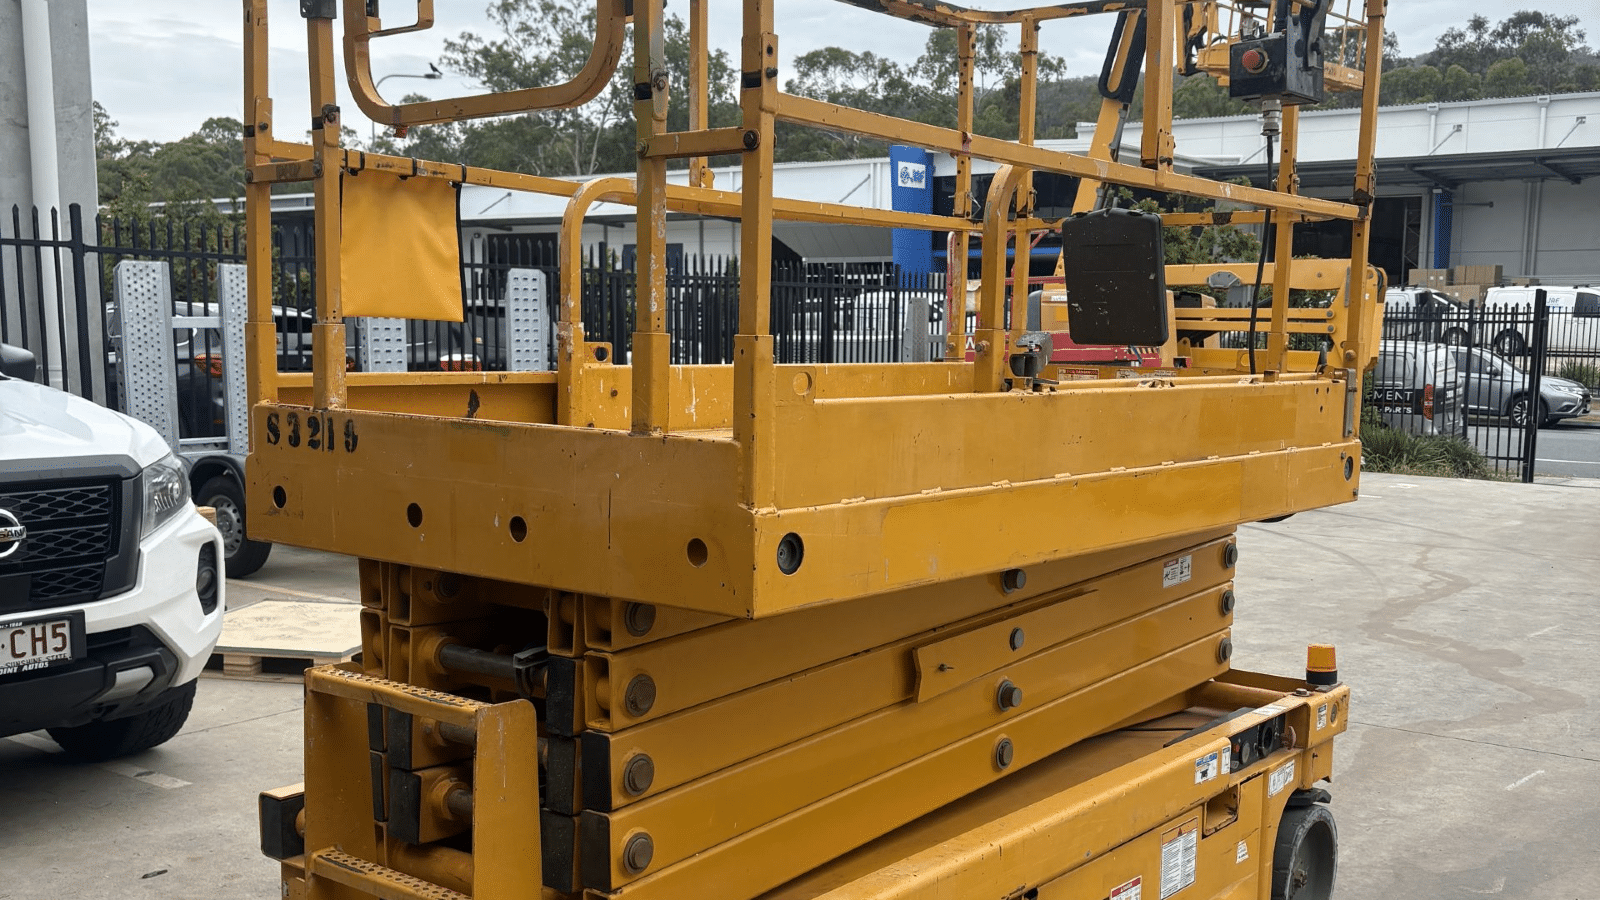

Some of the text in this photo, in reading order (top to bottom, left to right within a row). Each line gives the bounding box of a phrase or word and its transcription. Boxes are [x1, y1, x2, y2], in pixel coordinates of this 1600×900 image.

[266, 411, 359, 453] S3219
[10, 623, 67, 658] CH5
[22, 662, 49, 671] AUTOS
